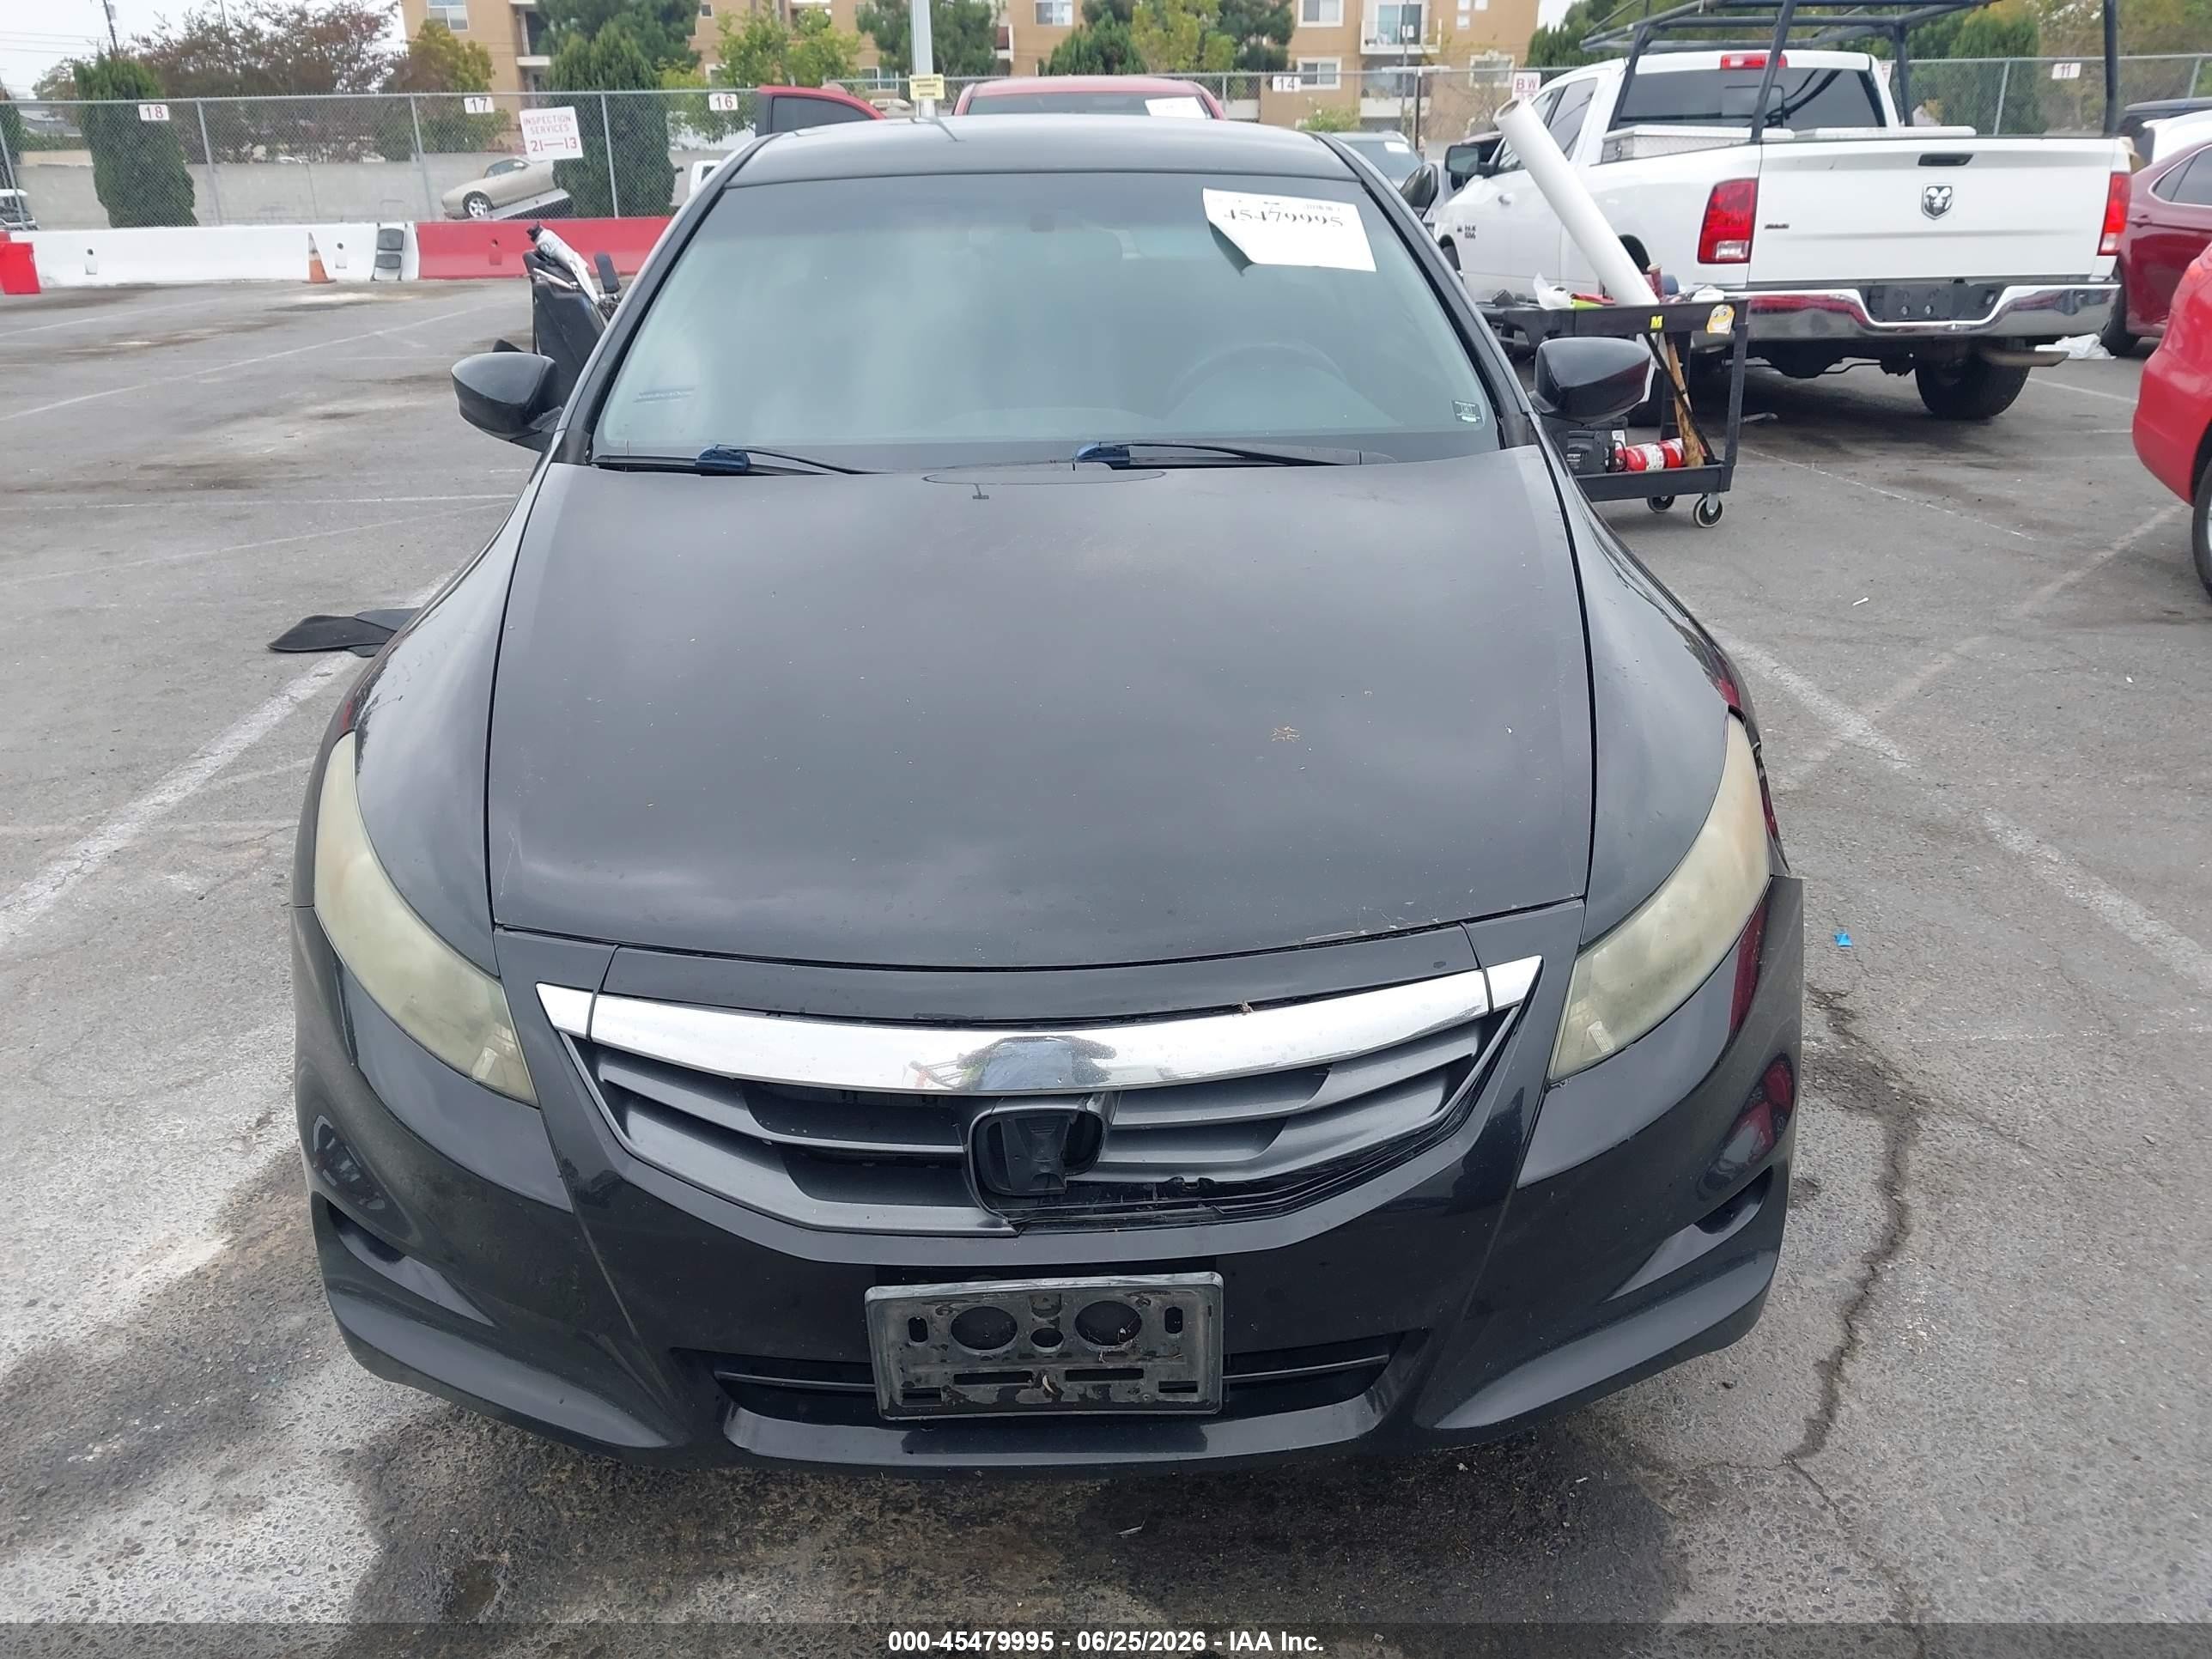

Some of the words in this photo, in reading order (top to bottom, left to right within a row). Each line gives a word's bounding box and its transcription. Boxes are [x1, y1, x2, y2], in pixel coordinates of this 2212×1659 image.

[1278, 76, 1295, 90] 14
[470, 97, 488, 111] 17
[715, 95, 733, 109] 16
[144, 106, 163, 118] 18
[523, 114, 571, 125] INSPECTION
[530, 123, 569, 135] SERVICES
